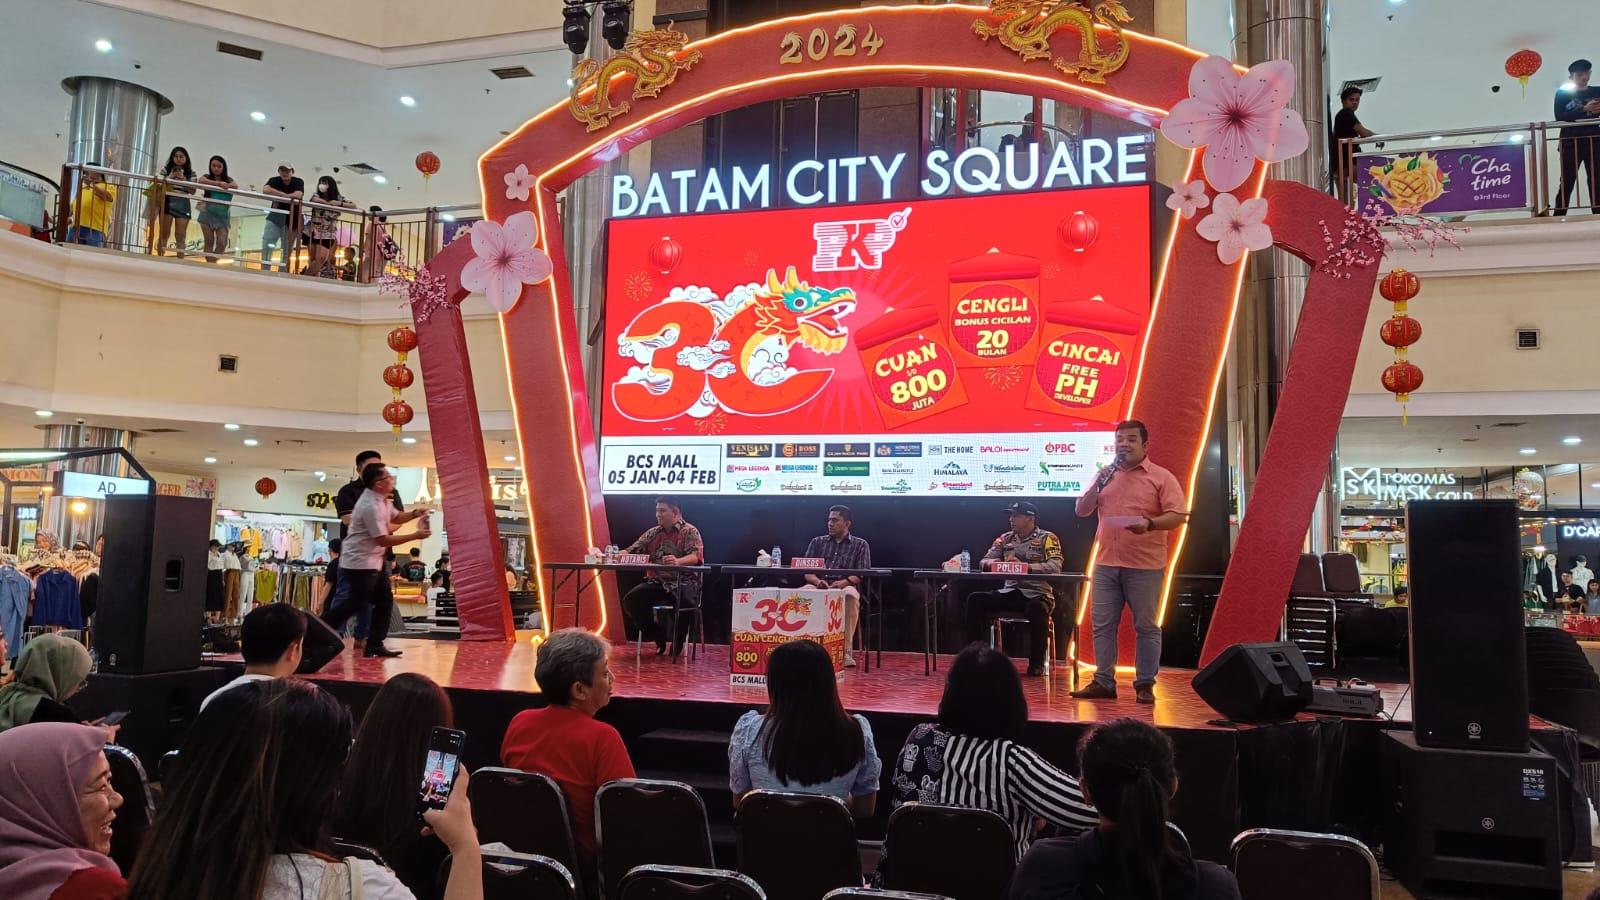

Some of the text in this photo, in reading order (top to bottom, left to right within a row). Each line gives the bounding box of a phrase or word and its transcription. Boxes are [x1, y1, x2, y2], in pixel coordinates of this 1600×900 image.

[780, 24, 884, 64] 2024
[1471, 158, 1511, 174] Cha
[611, 134, 1149, 217] BATAM CITY SQUARE
[1471, 174, 1511, 191] time
[956, 298, 1028, 314] CENGLI
[954, 316, 1032, 326] BONUS CICILAN
[976, 330, 1009, 349] 20
[875, 342, 938, 377] CUAN
[978, 348, 1007, 356] BULAN
[1048, 341, 1121, 366] CINCAI
[1061, 363, 1099, 378] FREE
[889, 368, 947, 404] 800
[1055, 375, 1099, 398] PH
[911, 396, 935, 411] JUTA
[1054, 393, 1092, 404] DEVELOPER
[626, 454, 698, 469] BCS MALL
[608, 470, 717, 484] 05 JAN-04 FEB
[1382, 473, 1456, 485] TOKO MAS
[97, 481, 117, 494] AD
[1384, 485, 1433, 500] MSK
[997, 563, 1023, 573] POLISI
[734, 633, 760, 642] CUAN
[736, 653, 758, 662] 800
[732, 675, 766, 684] BCS MALL
